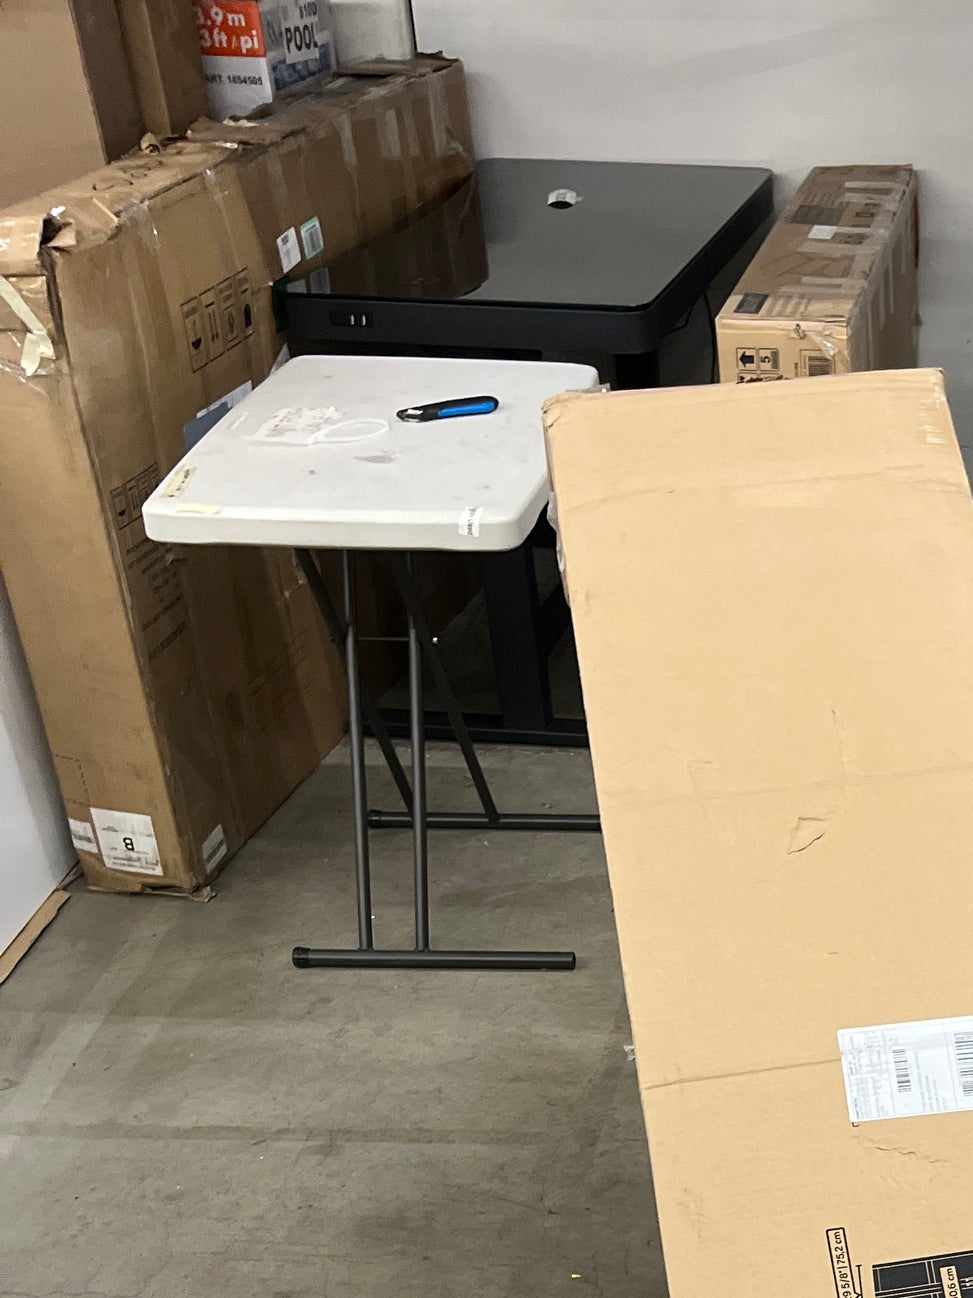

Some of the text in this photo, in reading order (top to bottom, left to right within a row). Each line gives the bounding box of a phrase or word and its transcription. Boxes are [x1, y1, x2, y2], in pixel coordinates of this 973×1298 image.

[284, 22, 318, 53] POOL
[834, 1231, 842, 1244] cm
[946, 1268, 955, 1281] cm
